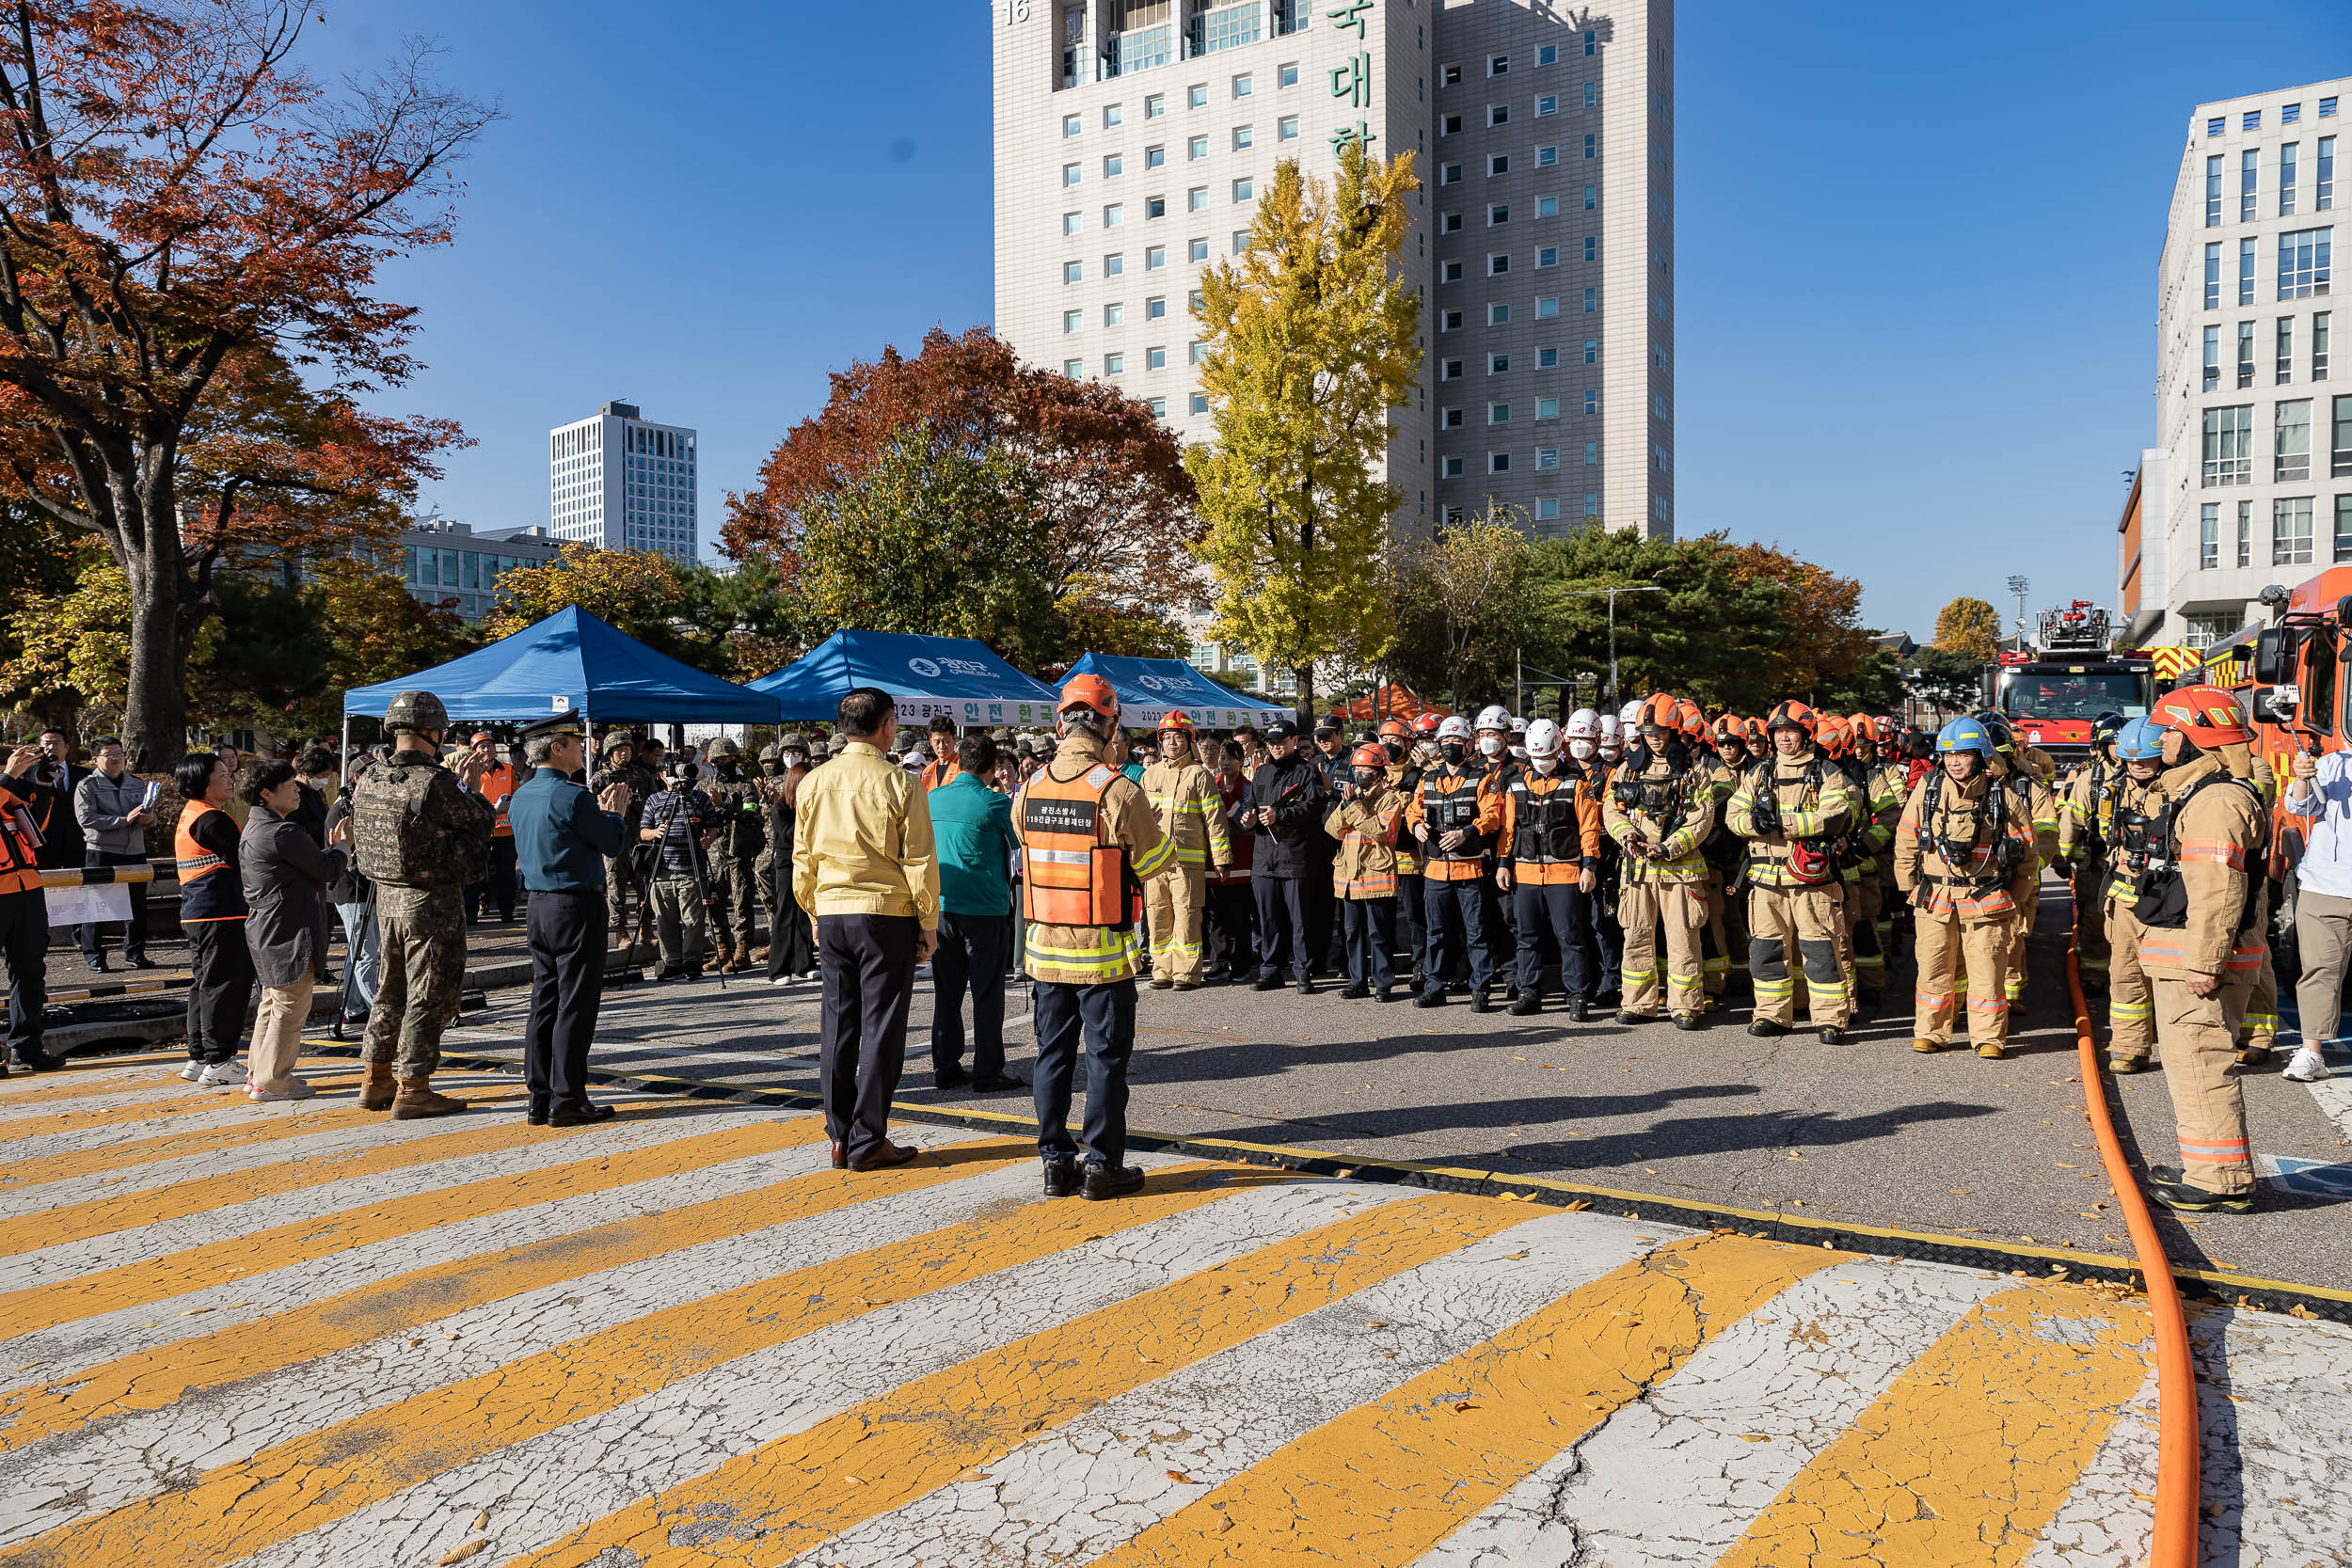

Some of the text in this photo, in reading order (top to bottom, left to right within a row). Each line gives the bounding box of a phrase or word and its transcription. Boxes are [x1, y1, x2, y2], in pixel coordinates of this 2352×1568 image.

[1002, 0, 1030, 25] 16
[936, 657, 988, 671] 광진구
[894, 704, 915, 717] 023
[922, 704, 953, 718] 광진구
[1141, 711, 1162, 721] 2023
[1041, 806, 1076, 816] 광진소방서
